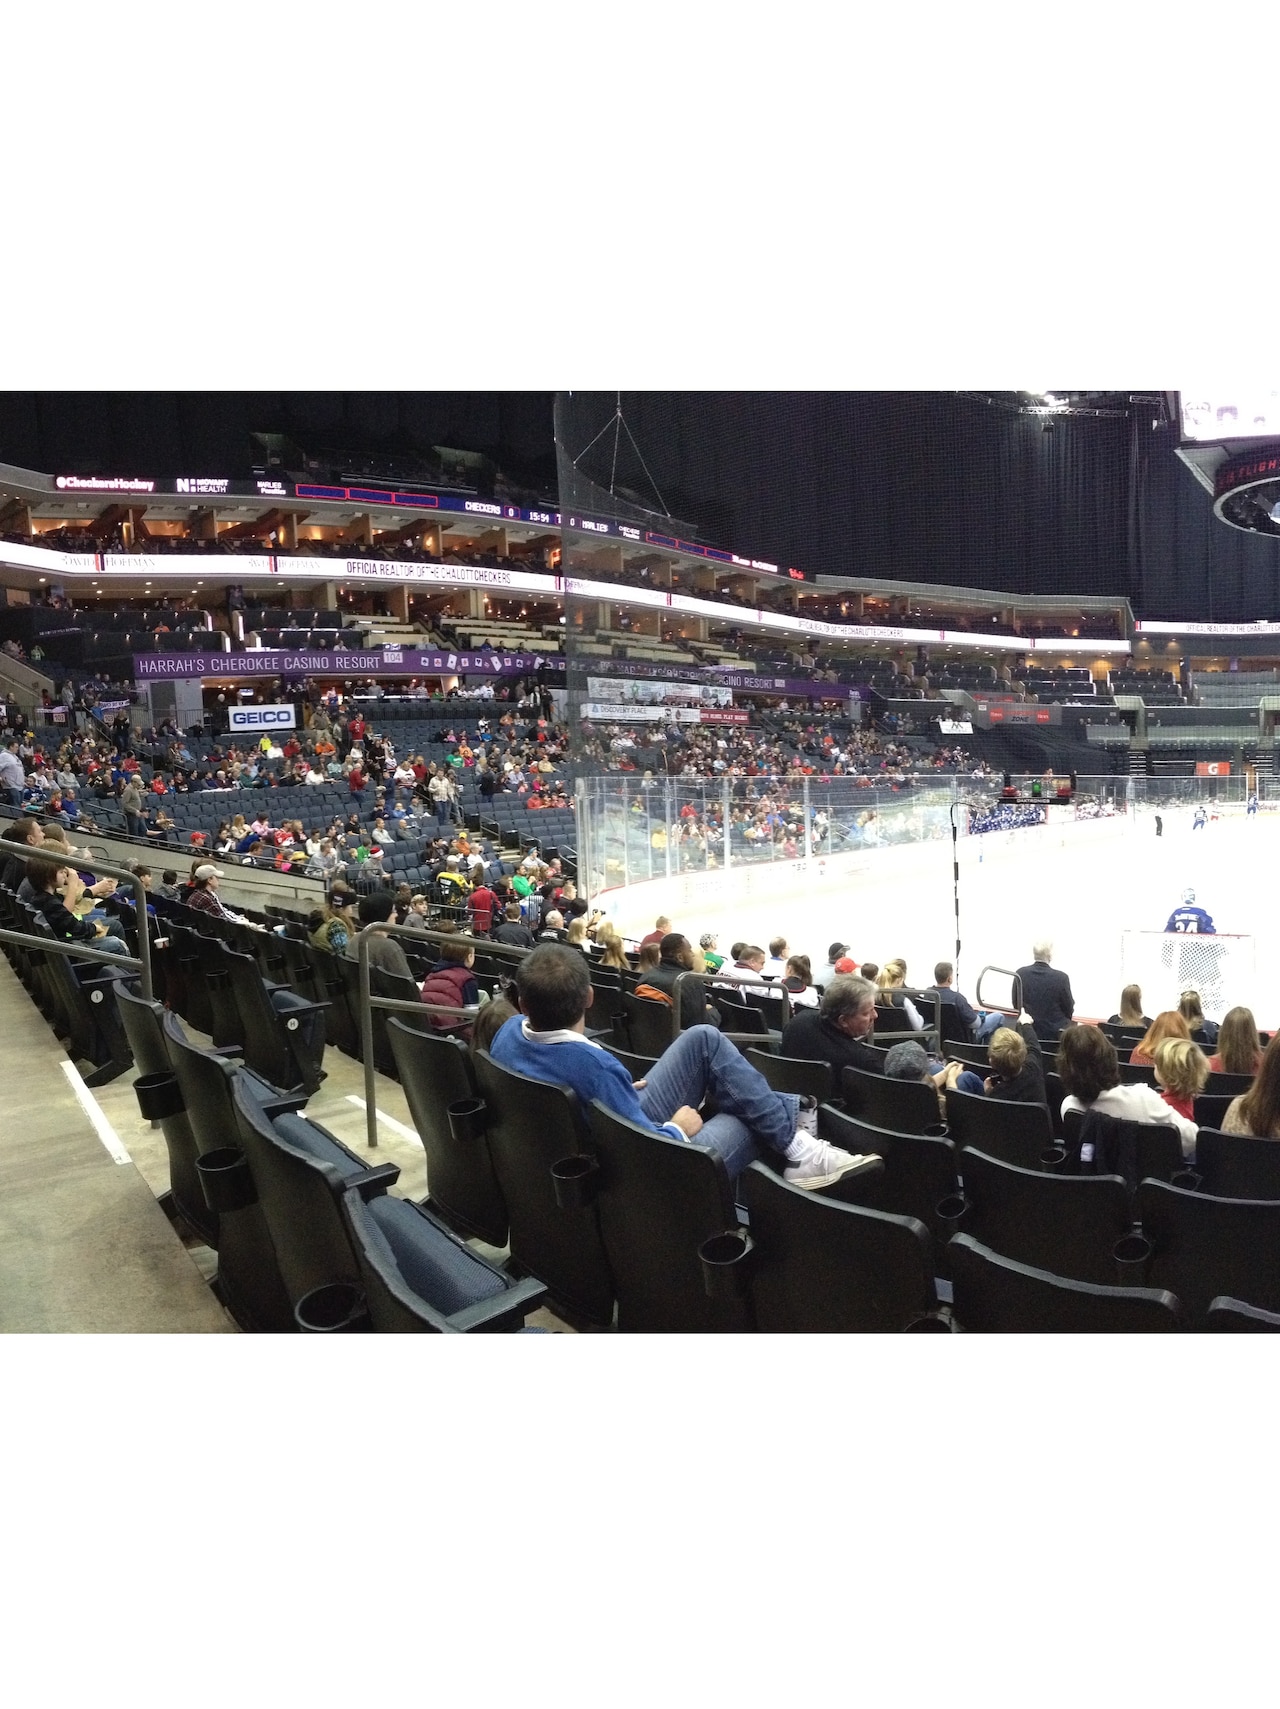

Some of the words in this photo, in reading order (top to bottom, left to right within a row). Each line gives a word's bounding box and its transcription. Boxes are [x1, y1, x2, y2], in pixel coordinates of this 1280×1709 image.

[56, 475, 154, 492] @CheckersHockey
[197, 485, 227, 493] HEALTH
[257, 481, 282, 489] MARLIES
[465, 500, 501, 516] CHECKERS
[509, 508, 515, 517] 0
[530, 511, 550, 523] 15:54
[582, 520, 609, 532] MARLIES
[385, 652, 402, 663] 104
[140, 658, 205, 674] HARRAH'S
[211, 657, 279, 673] CHEROKEE
[284, 656, 329, 671] CASINO
[335, 655, 380, 670] RESORT
[744, 677, 773, 689] RESORT
[600, 705, 630, 714] DISCOVERY
[631, 706, 648, 715] PLACE
[233, 710, 292, 725] GEICO
[1208, 763, 1218, 775] G
